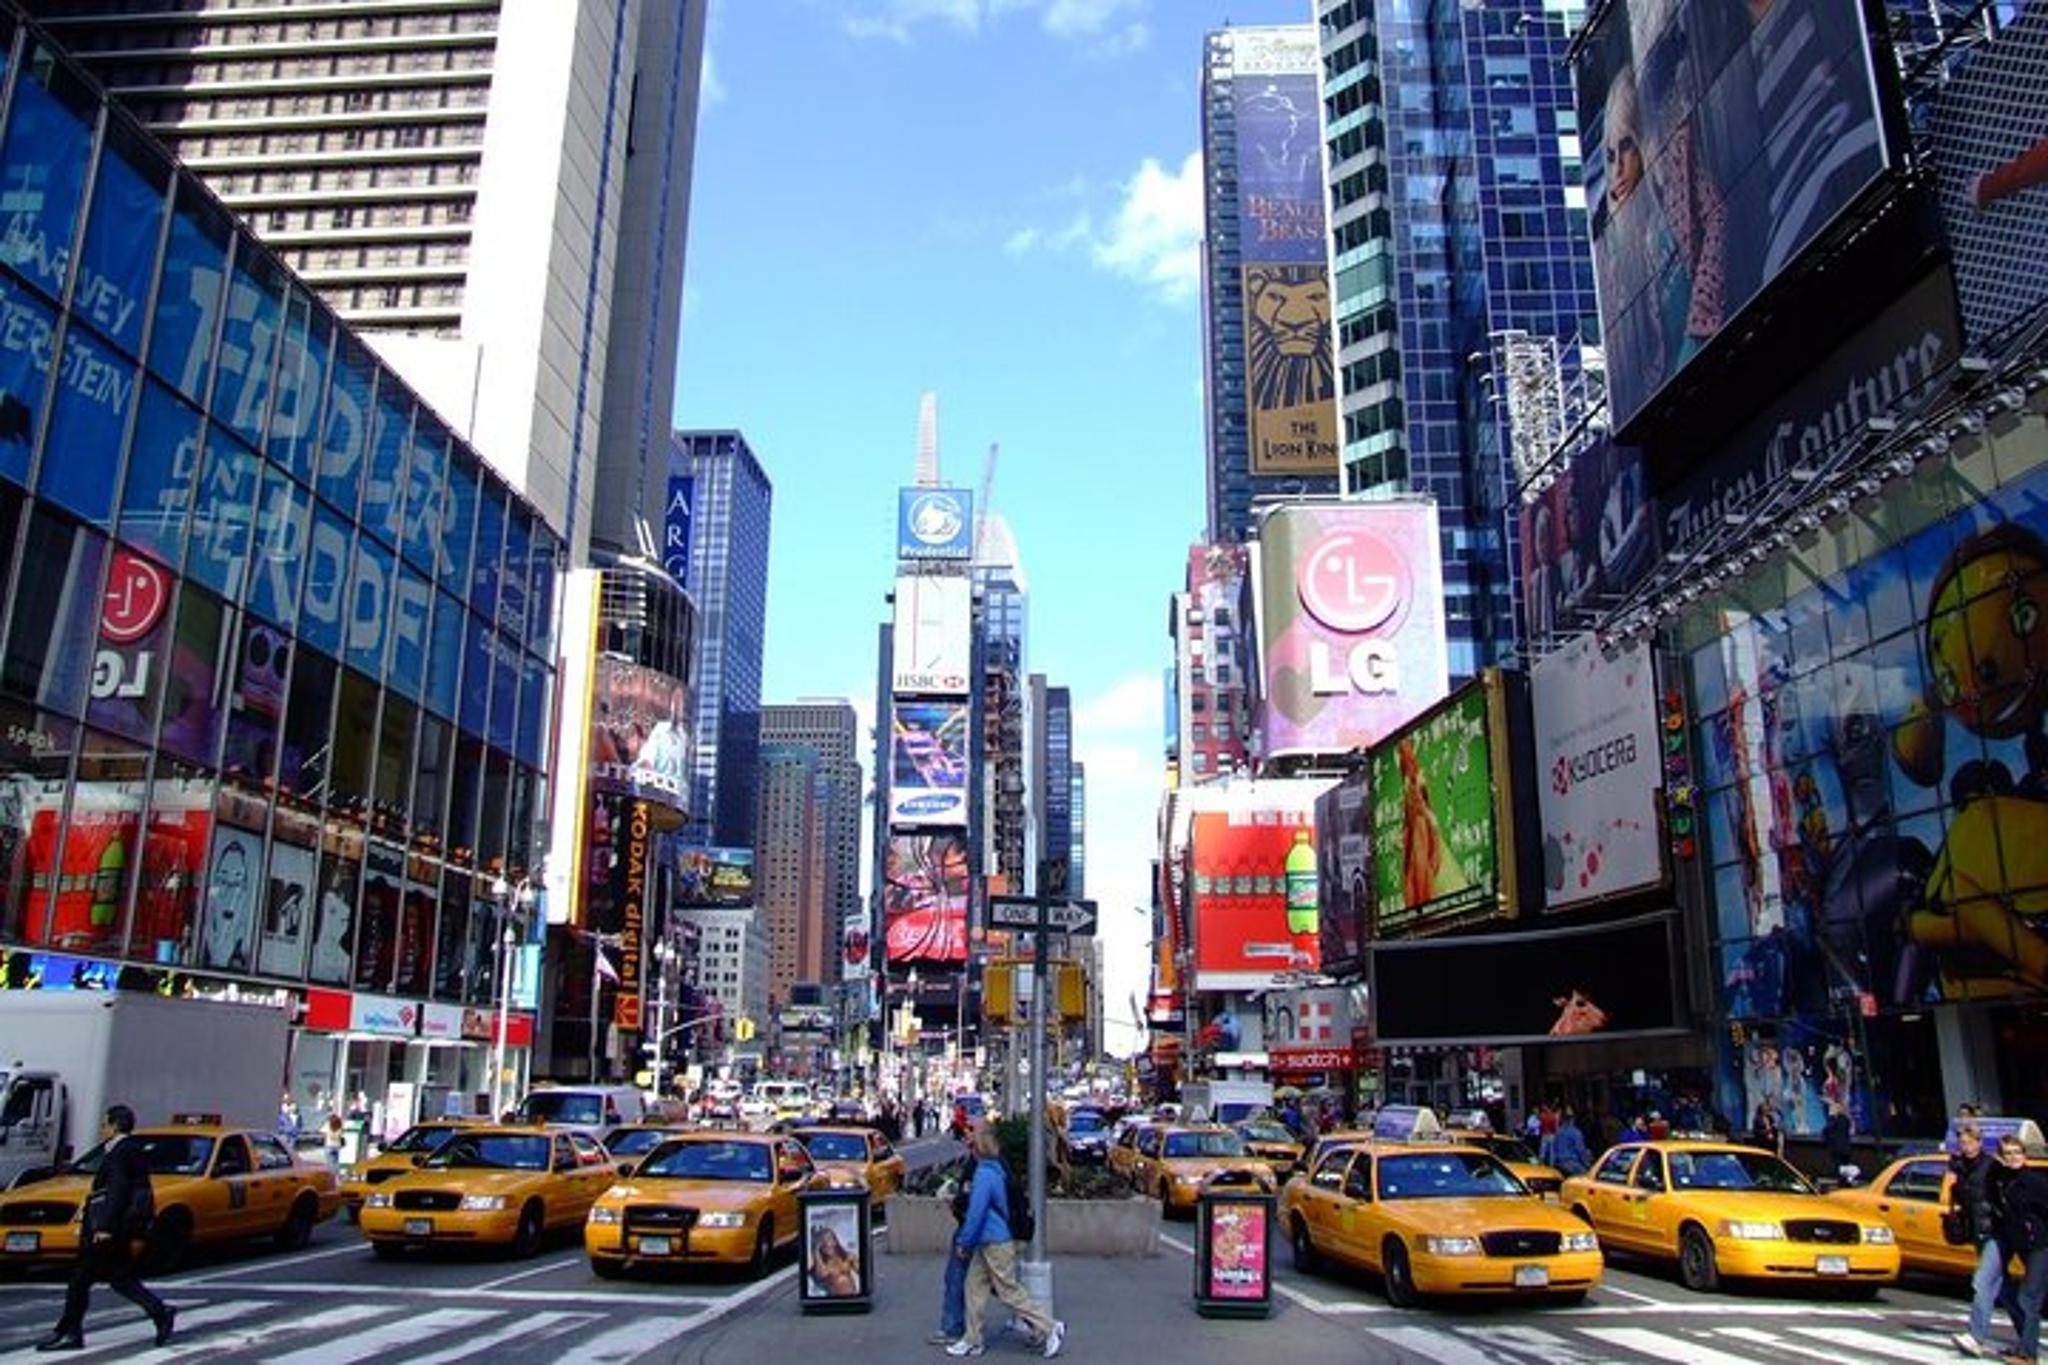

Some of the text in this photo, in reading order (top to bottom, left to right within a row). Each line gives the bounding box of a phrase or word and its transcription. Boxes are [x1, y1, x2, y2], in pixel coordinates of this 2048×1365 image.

[1291, 421, 1318, 434] THE
[1263, 438, 1302, 459] LION
[901, 544, 969, 557] Prudential
[1310, 640, 1399, 698] LG
[898, 673, 941, 688] HSBC
[1567, 732, 1637, 785] KYOCERA
[621, 802, 648, 988] KODAK digital
[1002, 906, 1084, 924] ONE WAY
[1288, 1053, 1340, 1067] swatch
